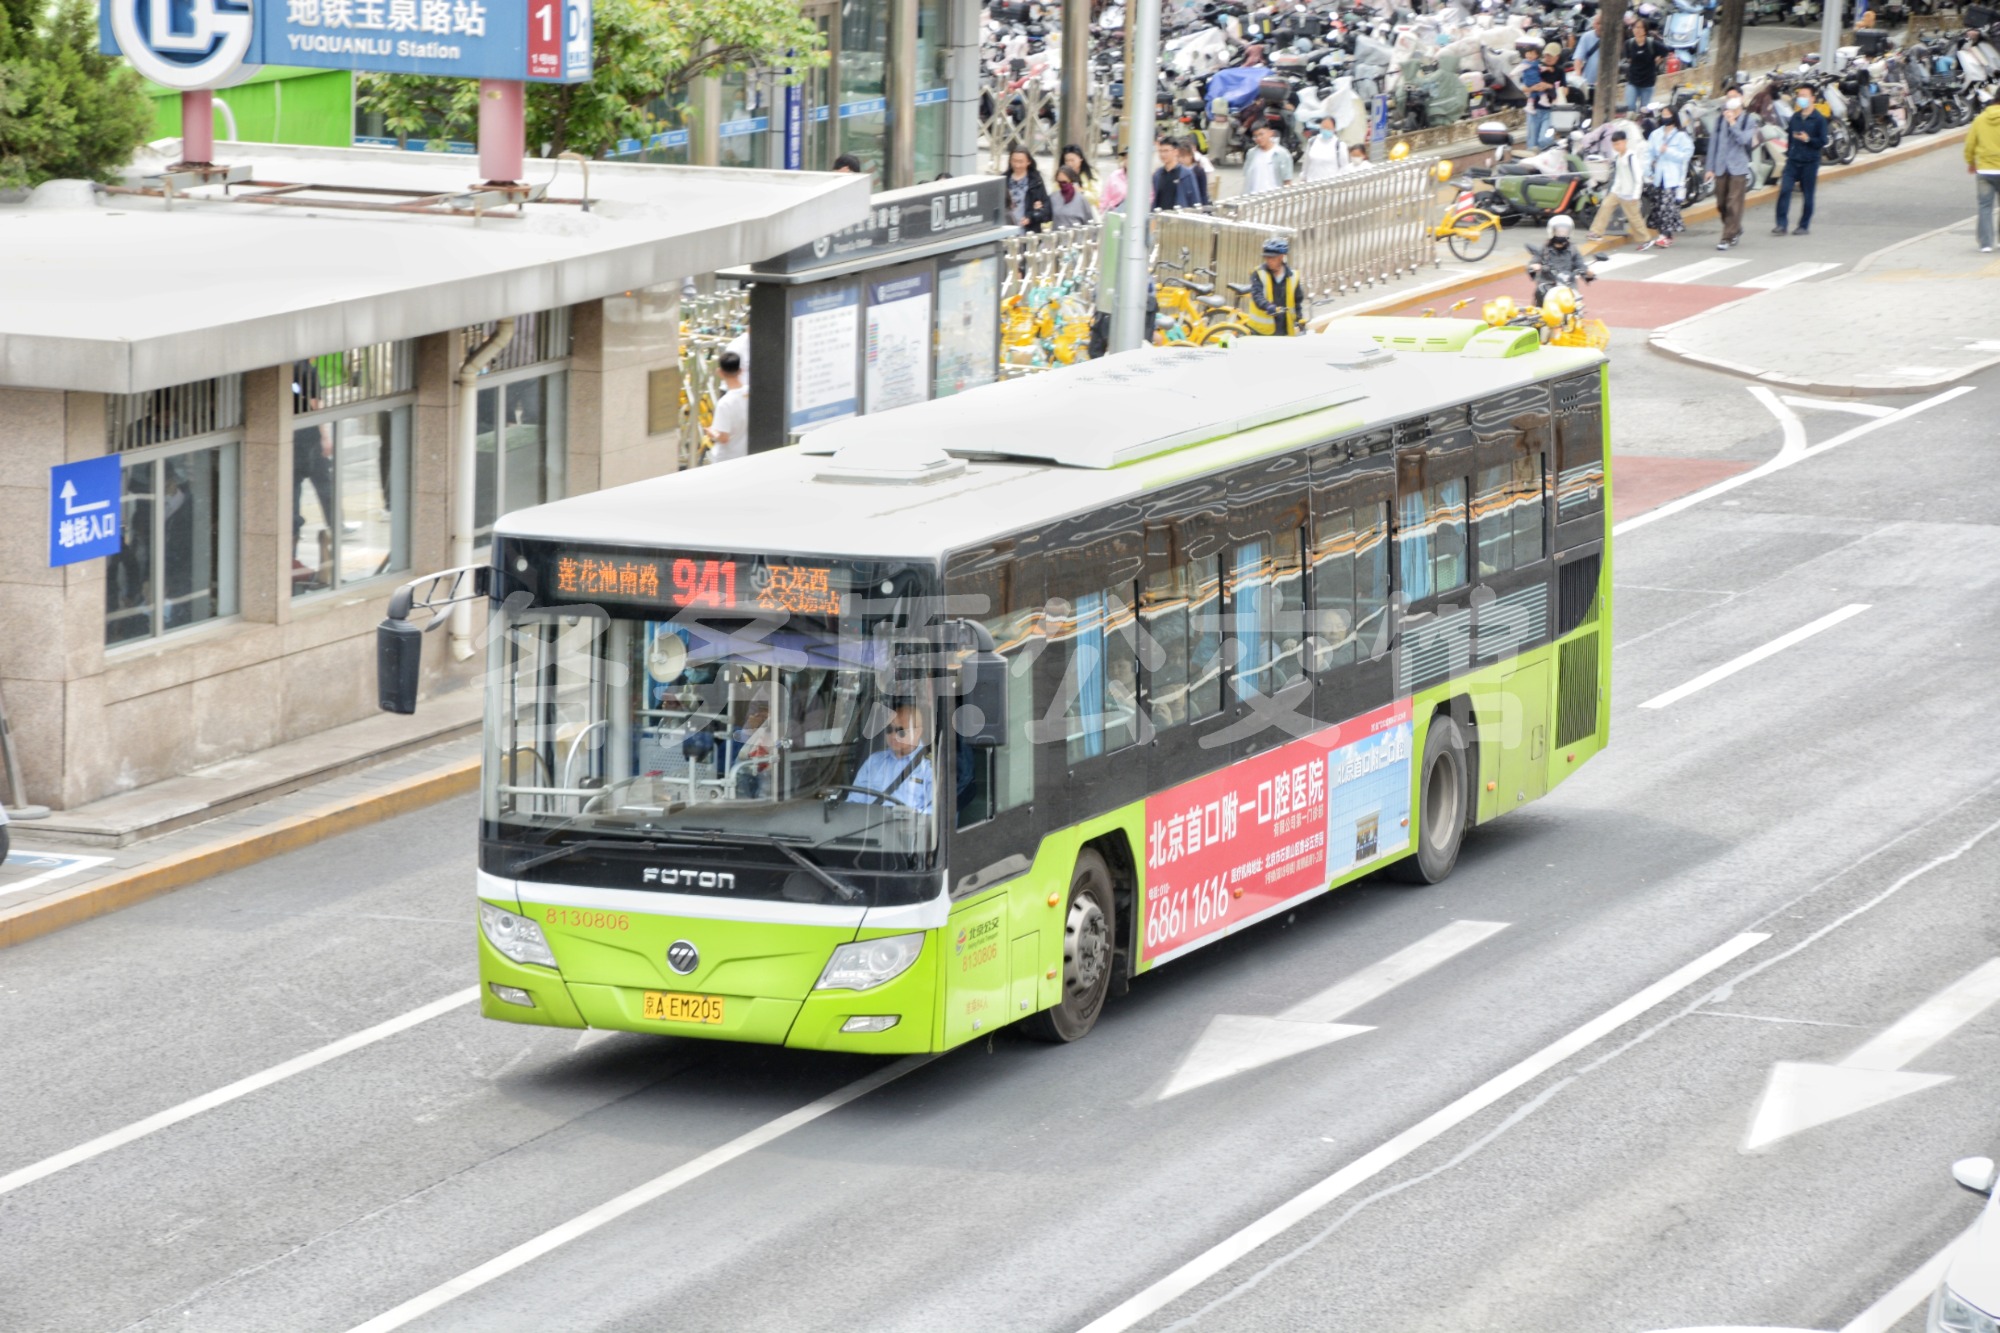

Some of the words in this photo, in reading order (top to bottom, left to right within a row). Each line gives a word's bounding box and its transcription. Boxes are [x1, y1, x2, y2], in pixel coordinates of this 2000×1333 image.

[287, 0, 488, 37] 地铁玉泉路站
[534, 4, 551, 41] 1
[287, 34, 392, 55] YUQUANLU
[397, 41, 461, 59] Station
[59, 513, 116, 548] 地铁入口
[558, 557, 659, 596] 莲花池南路
[672, 558, 736, 608] 941
[767, 565, 831, 593] 石龙西
[1149, 757, 1324, 870] 北京首口附一口腔医院
[546, 907, 630, 931] 8130806
[969, 916, 999, 940] 北京公交
[962, 943, 997, 973] 8130806
